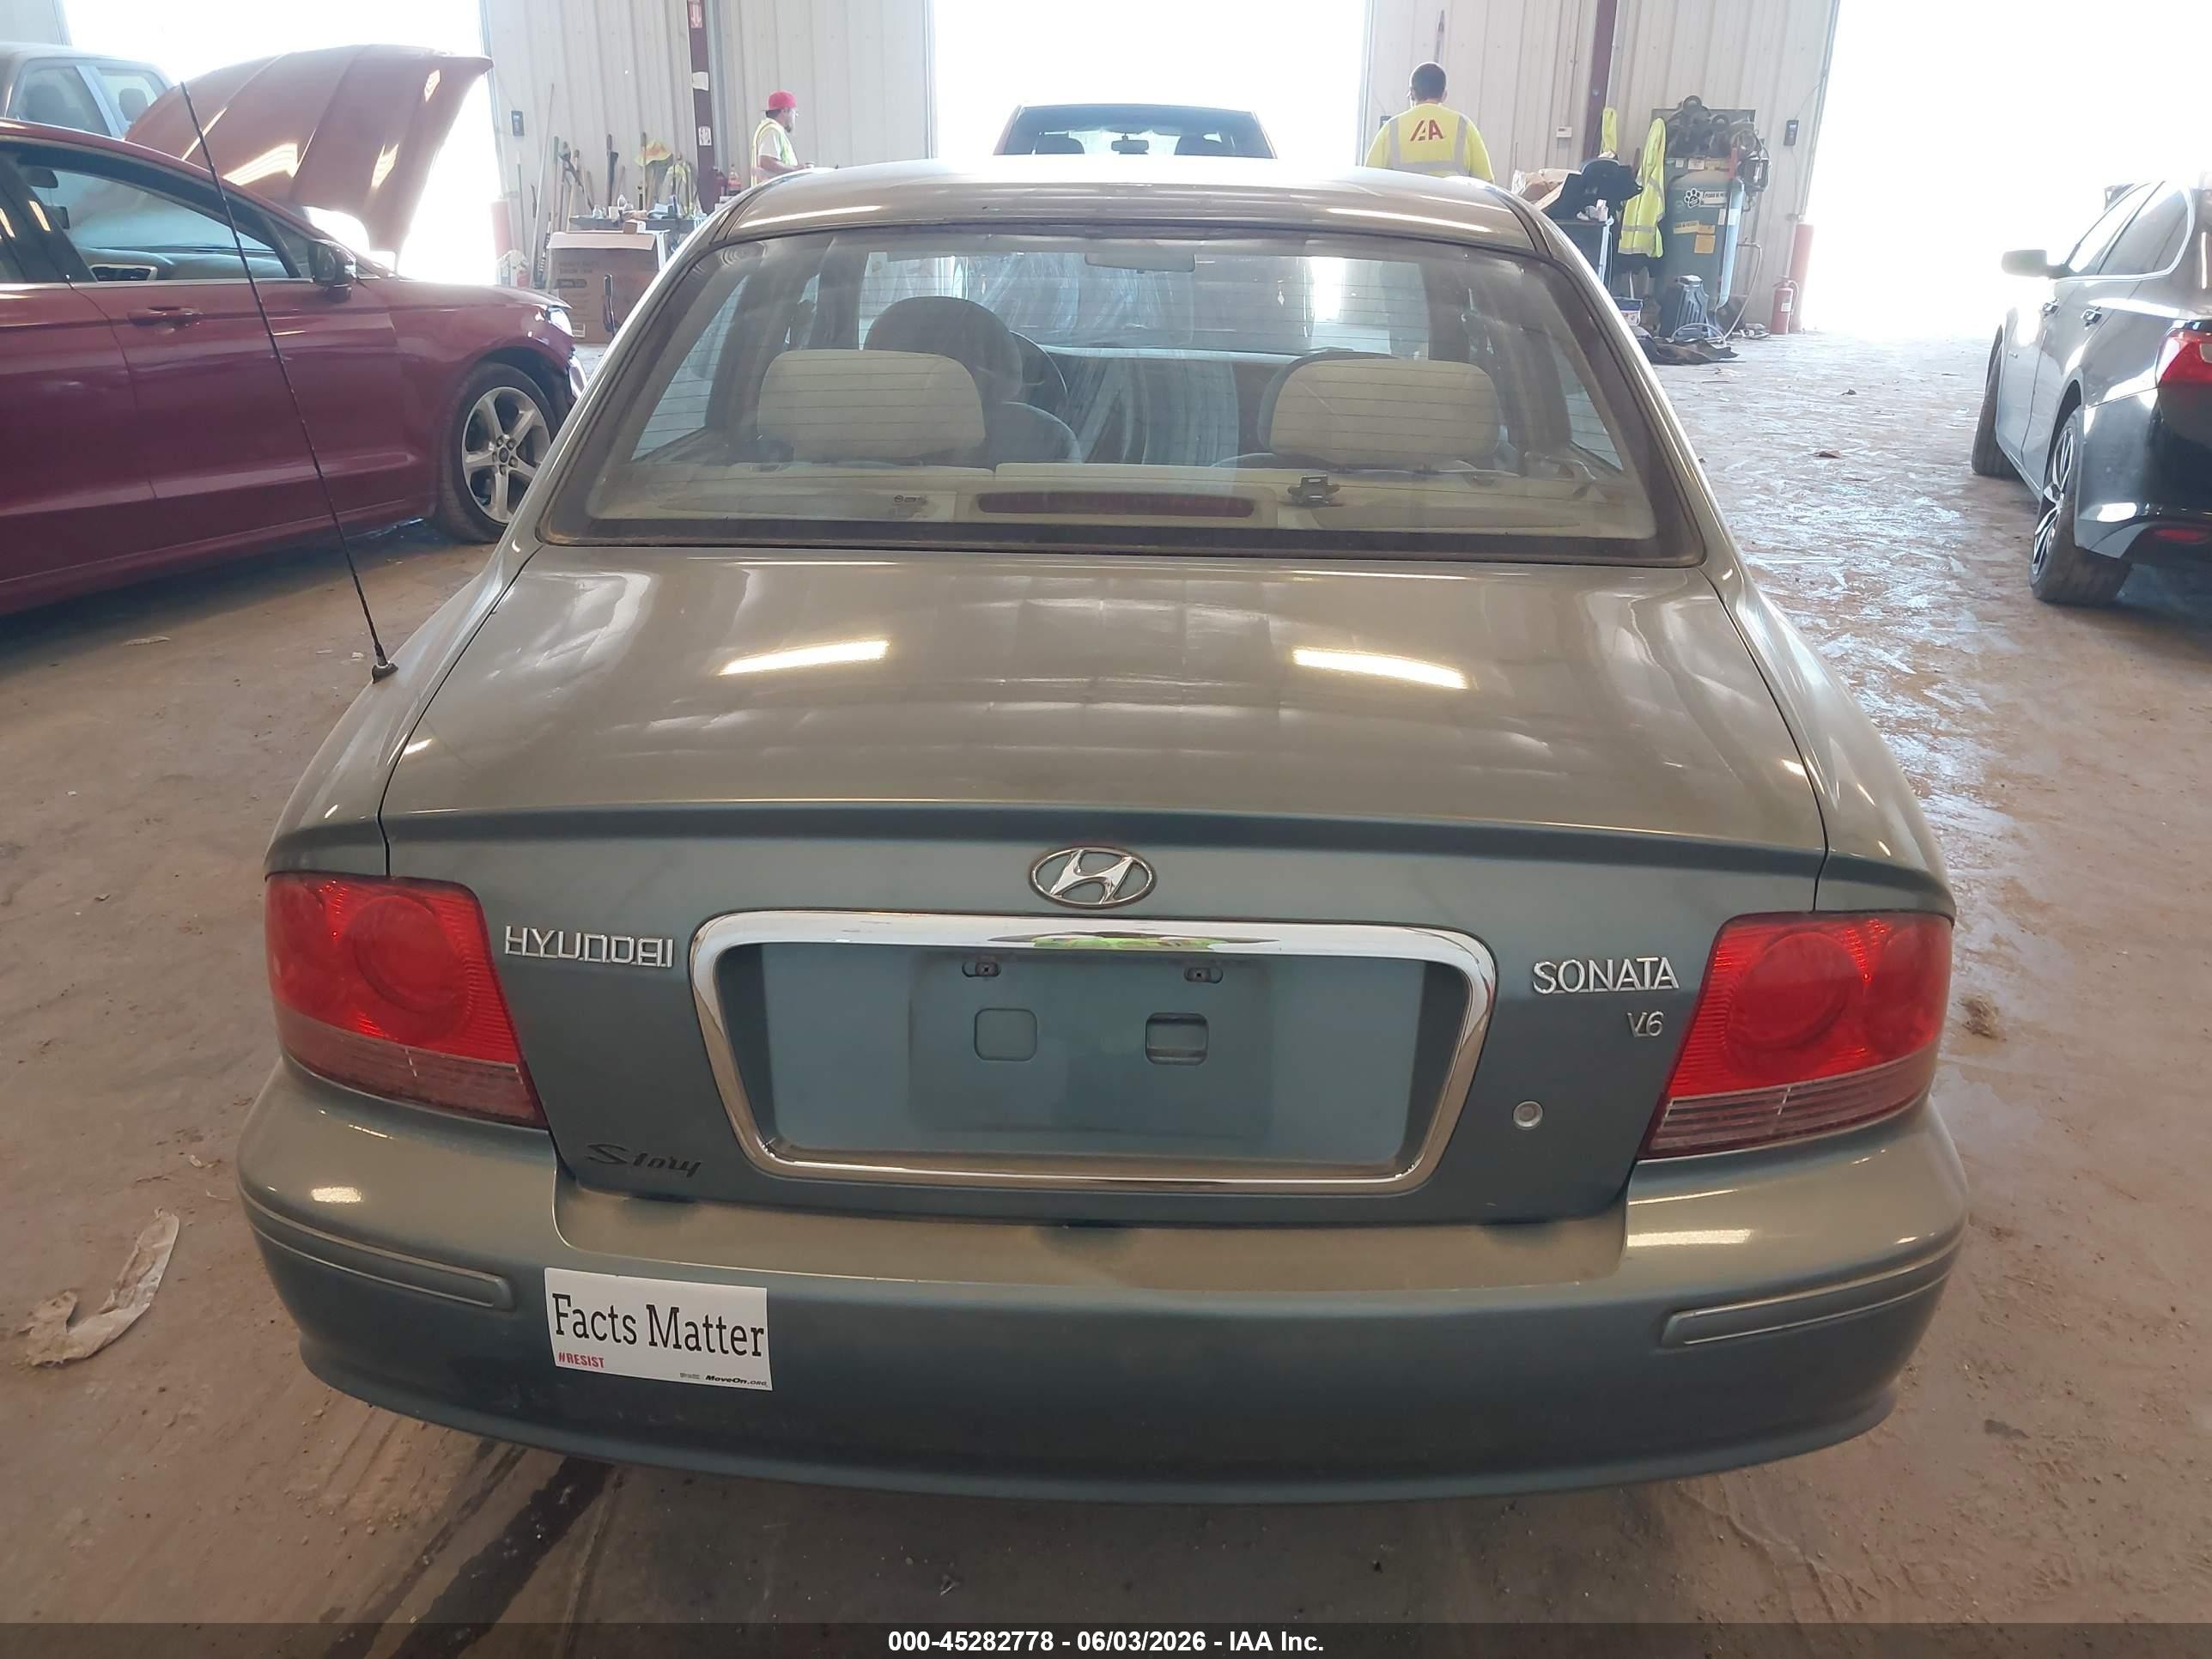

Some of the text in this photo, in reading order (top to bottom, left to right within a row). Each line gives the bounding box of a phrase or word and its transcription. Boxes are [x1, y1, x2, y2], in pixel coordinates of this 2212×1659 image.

[505, 925, 674, 968] HYUNDAI
[1533, 957, 1680, 994] SONATA
[1627, 1011, 1664, 1037] V6
[552, 1293, 764, 1357] Facts Matter
[559, 1352, 605, 1368] #RESIST
